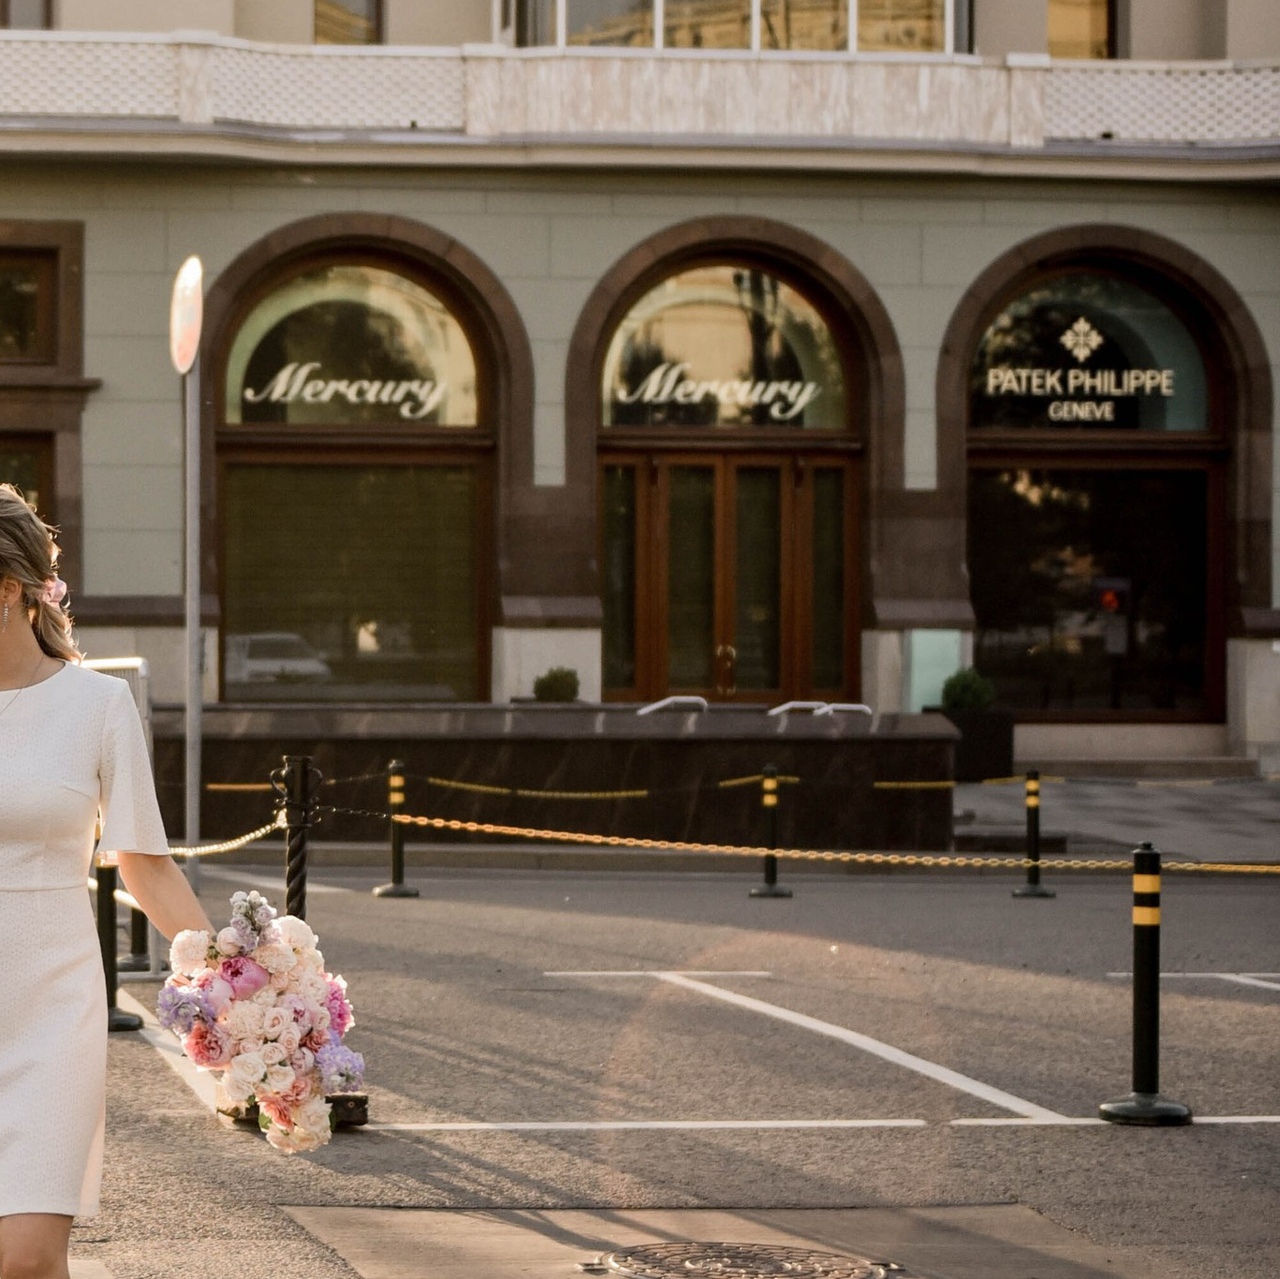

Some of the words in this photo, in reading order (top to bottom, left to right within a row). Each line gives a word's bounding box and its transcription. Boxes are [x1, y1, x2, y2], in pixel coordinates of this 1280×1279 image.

[244, 362, 447, 419] Mercury
[617, 362, 820, 419] Mercury
[987, 368, 1063, 396] PATEK
[1068, 369, 1175, 396] PHILIPPE
[1048, 401, 1115, 421] GENEVE
